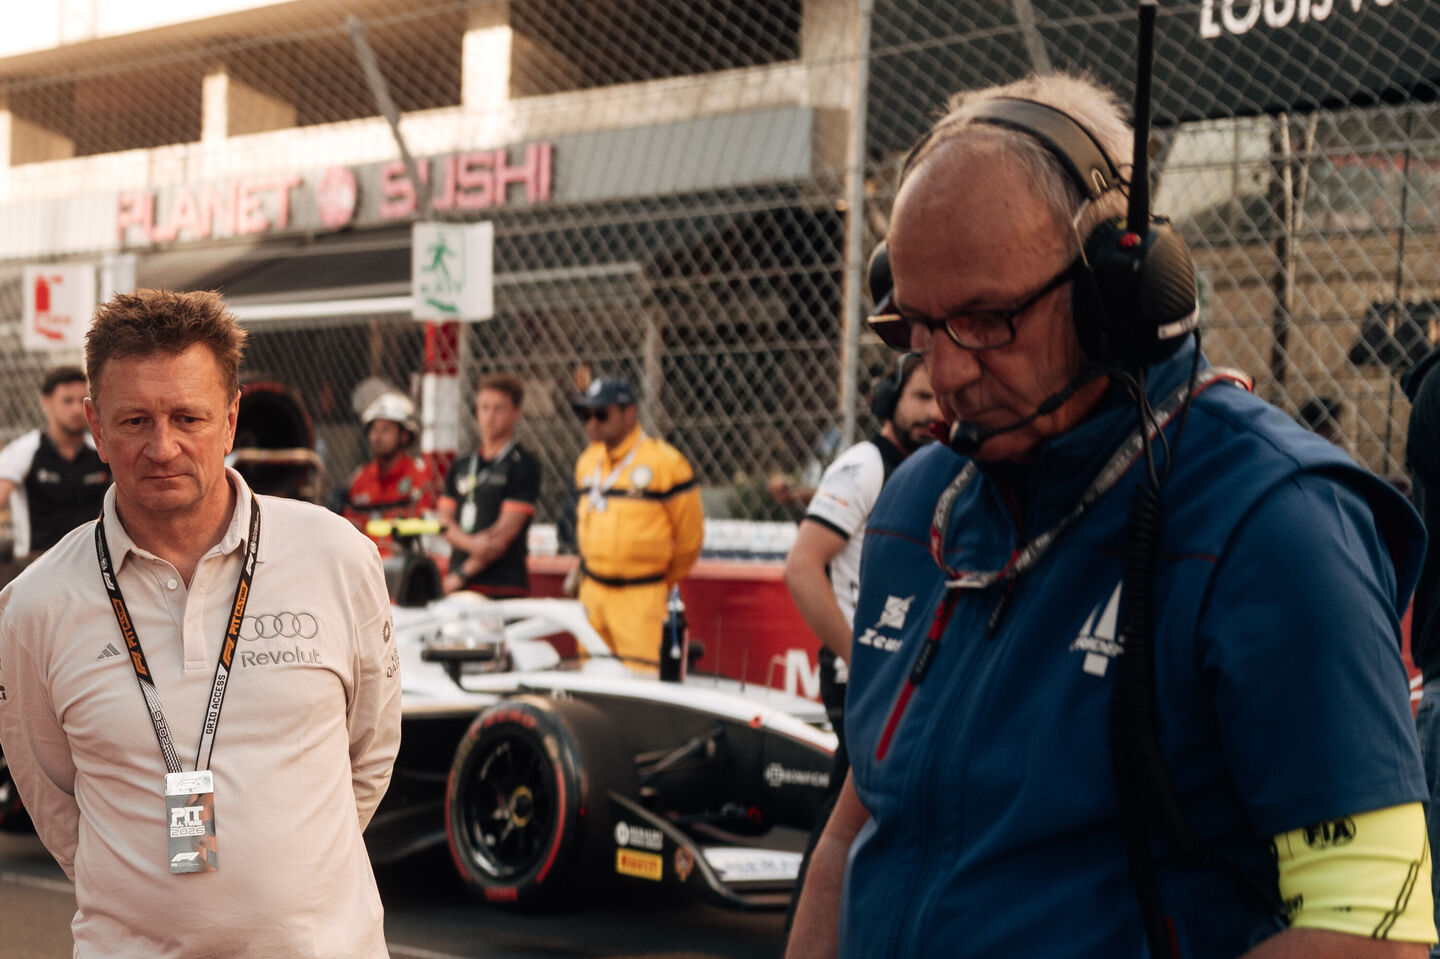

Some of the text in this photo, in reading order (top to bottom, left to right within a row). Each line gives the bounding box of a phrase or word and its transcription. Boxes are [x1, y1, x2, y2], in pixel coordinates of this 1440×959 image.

[117, 141, 552, 243] PLANET SUSHI
[241, 646, 322, 668] Revolut
[205, 674, 226, 735] GRID ACCESS
[154, 711, 171, 746] 2026
[171, 806, 204, 827] PIT
[171, 827, 205, 837] 2026
